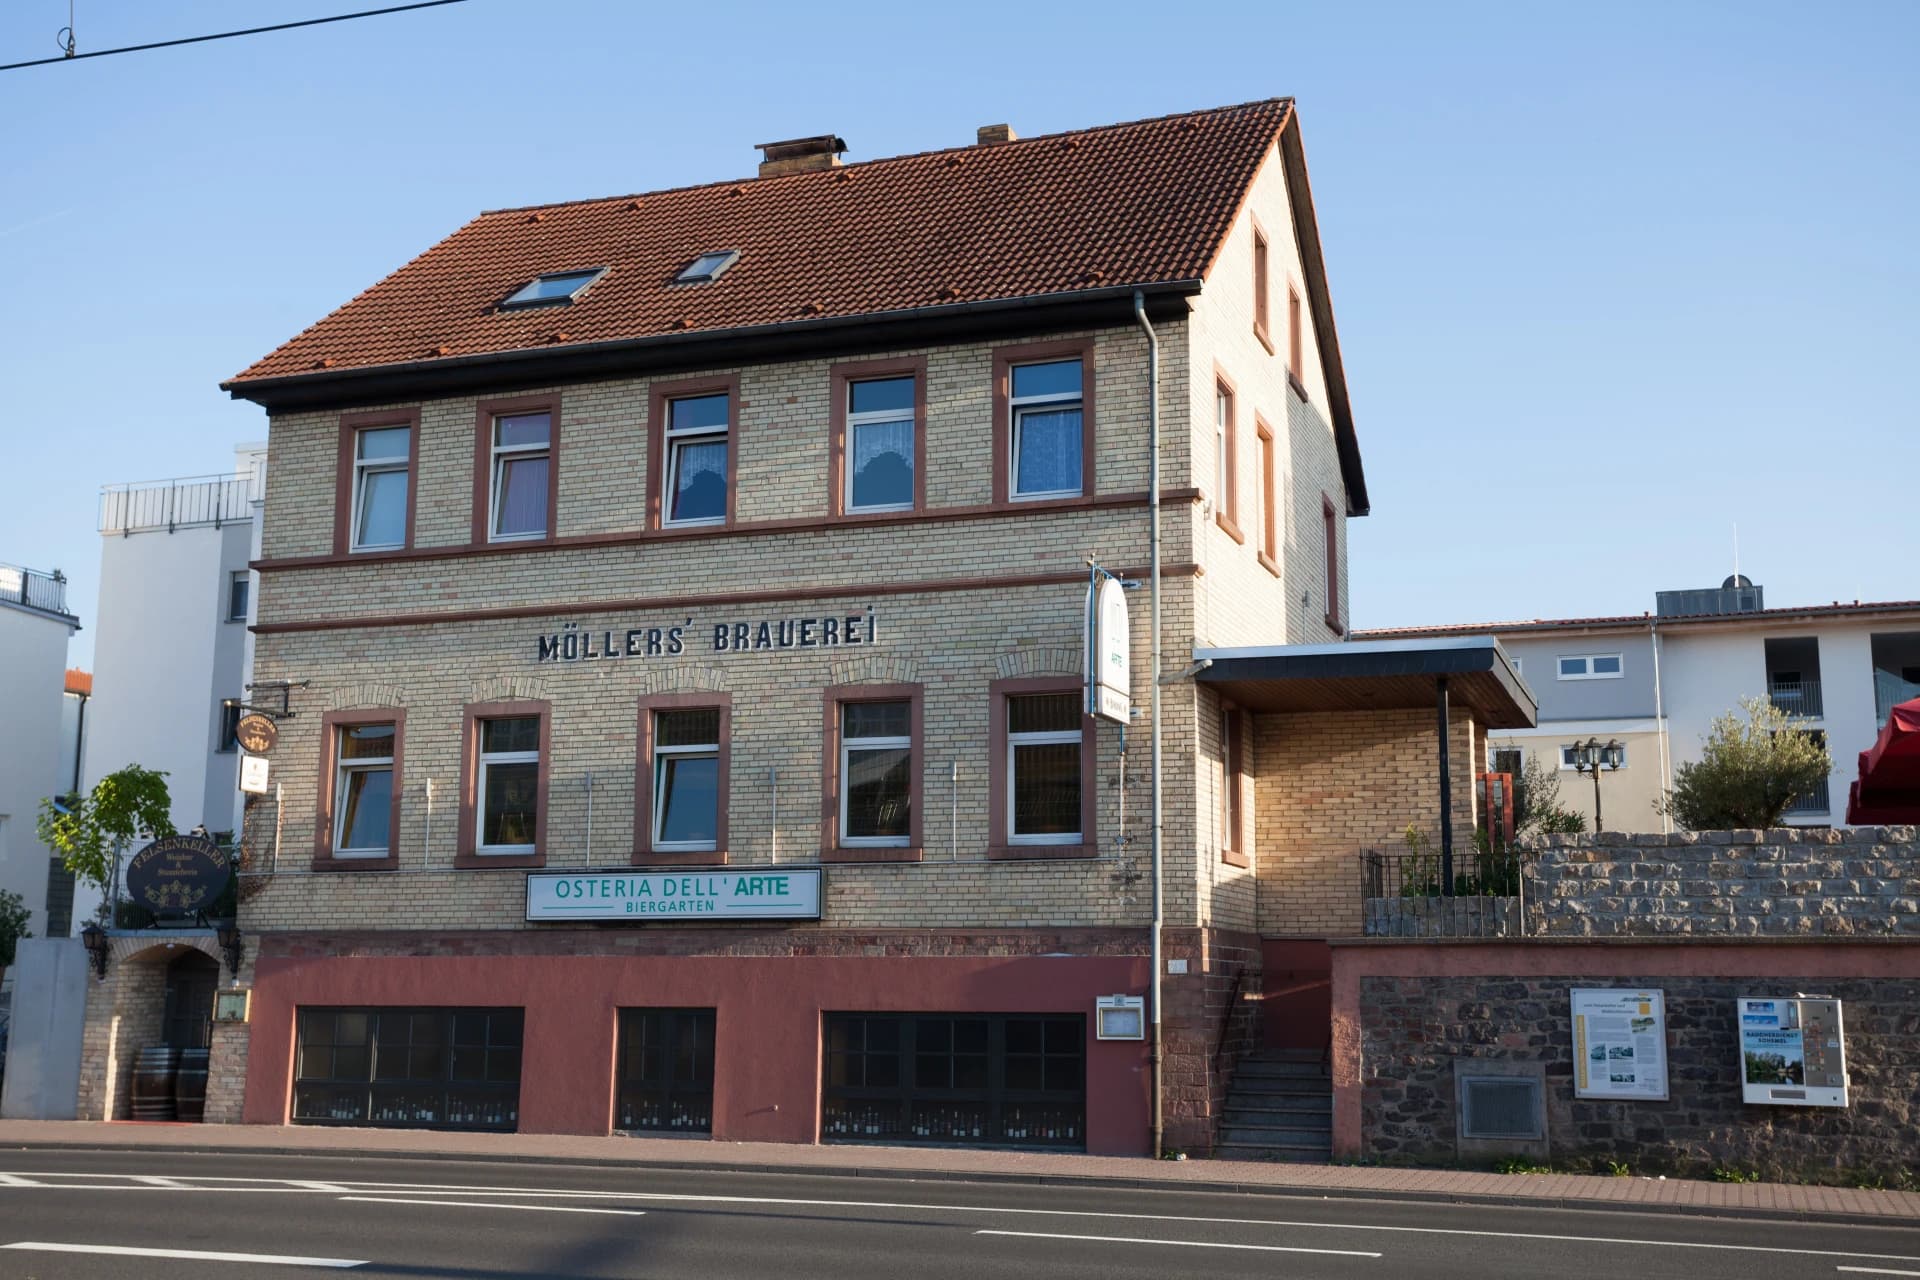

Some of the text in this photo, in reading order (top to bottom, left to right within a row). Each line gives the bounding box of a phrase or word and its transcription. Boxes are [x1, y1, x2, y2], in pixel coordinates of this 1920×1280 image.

[133, 837, 225, 869] FELSENKELLER
[555, 876, 789, 899] OSTERIA DELL' ARTE
[626, 899, 715, 913] BIERGARTEN
